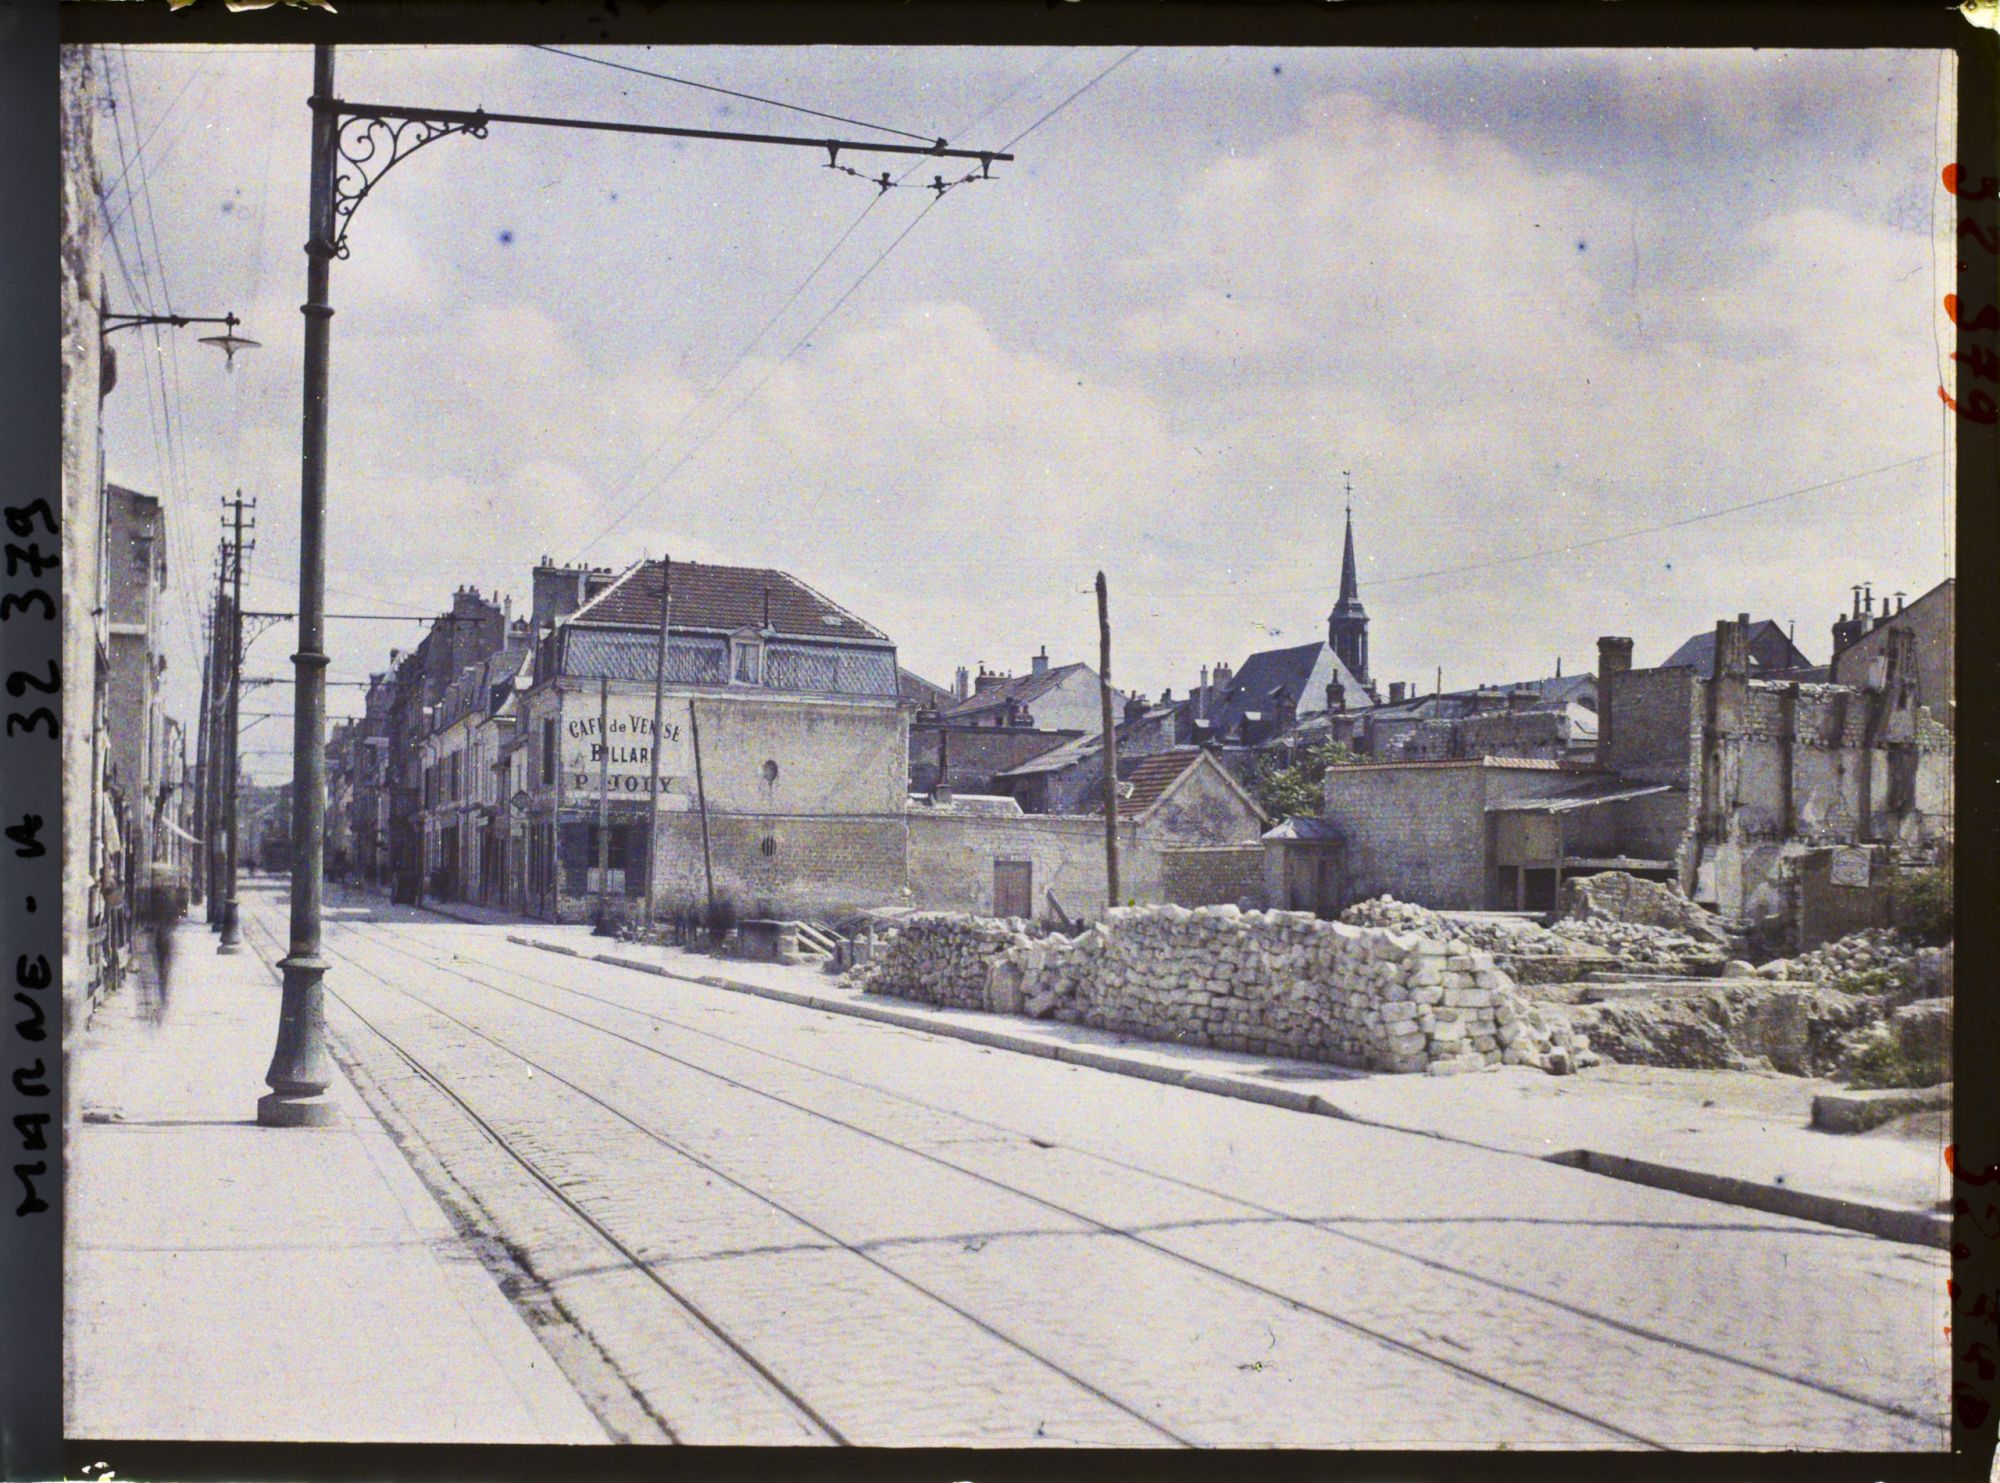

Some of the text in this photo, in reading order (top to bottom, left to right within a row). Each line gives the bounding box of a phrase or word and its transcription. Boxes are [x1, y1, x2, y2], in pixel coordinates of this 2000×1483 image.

[0, 497, 61, 622] 379
[5, 658, 61, 740] 32
[609, 719, 626, 733] de
[629, 714, 682, 743] VENSE
[590, 743, 657, 763] BLLAR
[12, 953, 52, 1218] MARNE
